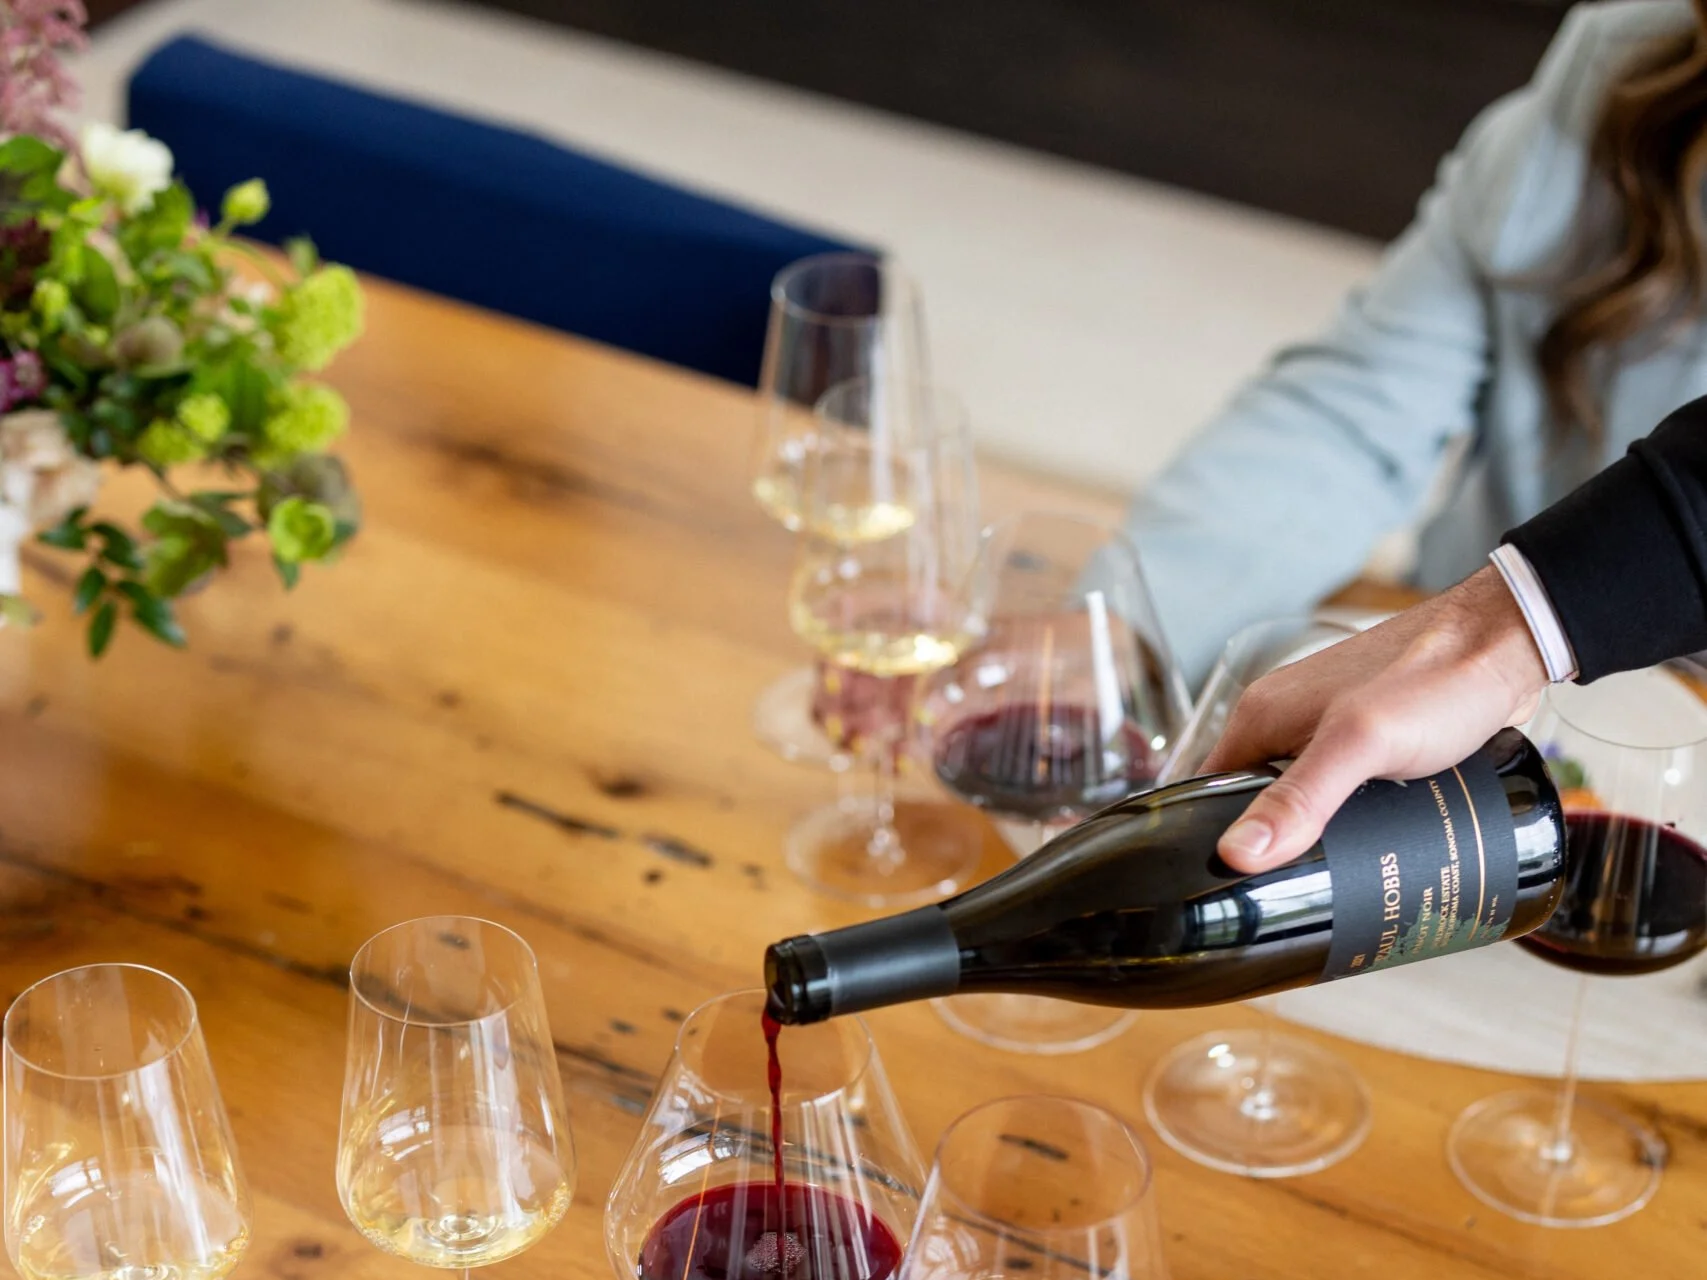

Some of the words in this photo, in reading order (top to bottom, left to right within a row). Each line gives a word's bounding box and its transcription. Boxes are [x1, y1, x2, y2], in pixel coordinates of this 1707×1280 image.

[1428, 779, 1450, 817] COUNTY
[1443, 818, 1459, 861] SONOMA
[1380, 852, 1401, 922] HOBBS
[1440, 866, 1451, 903] ESTATE
[1450, 861, 1461, 894] COAST,
[1422, 886, 1434, 922] NOIR
[1374, 923, 1399, 962] PAUL
